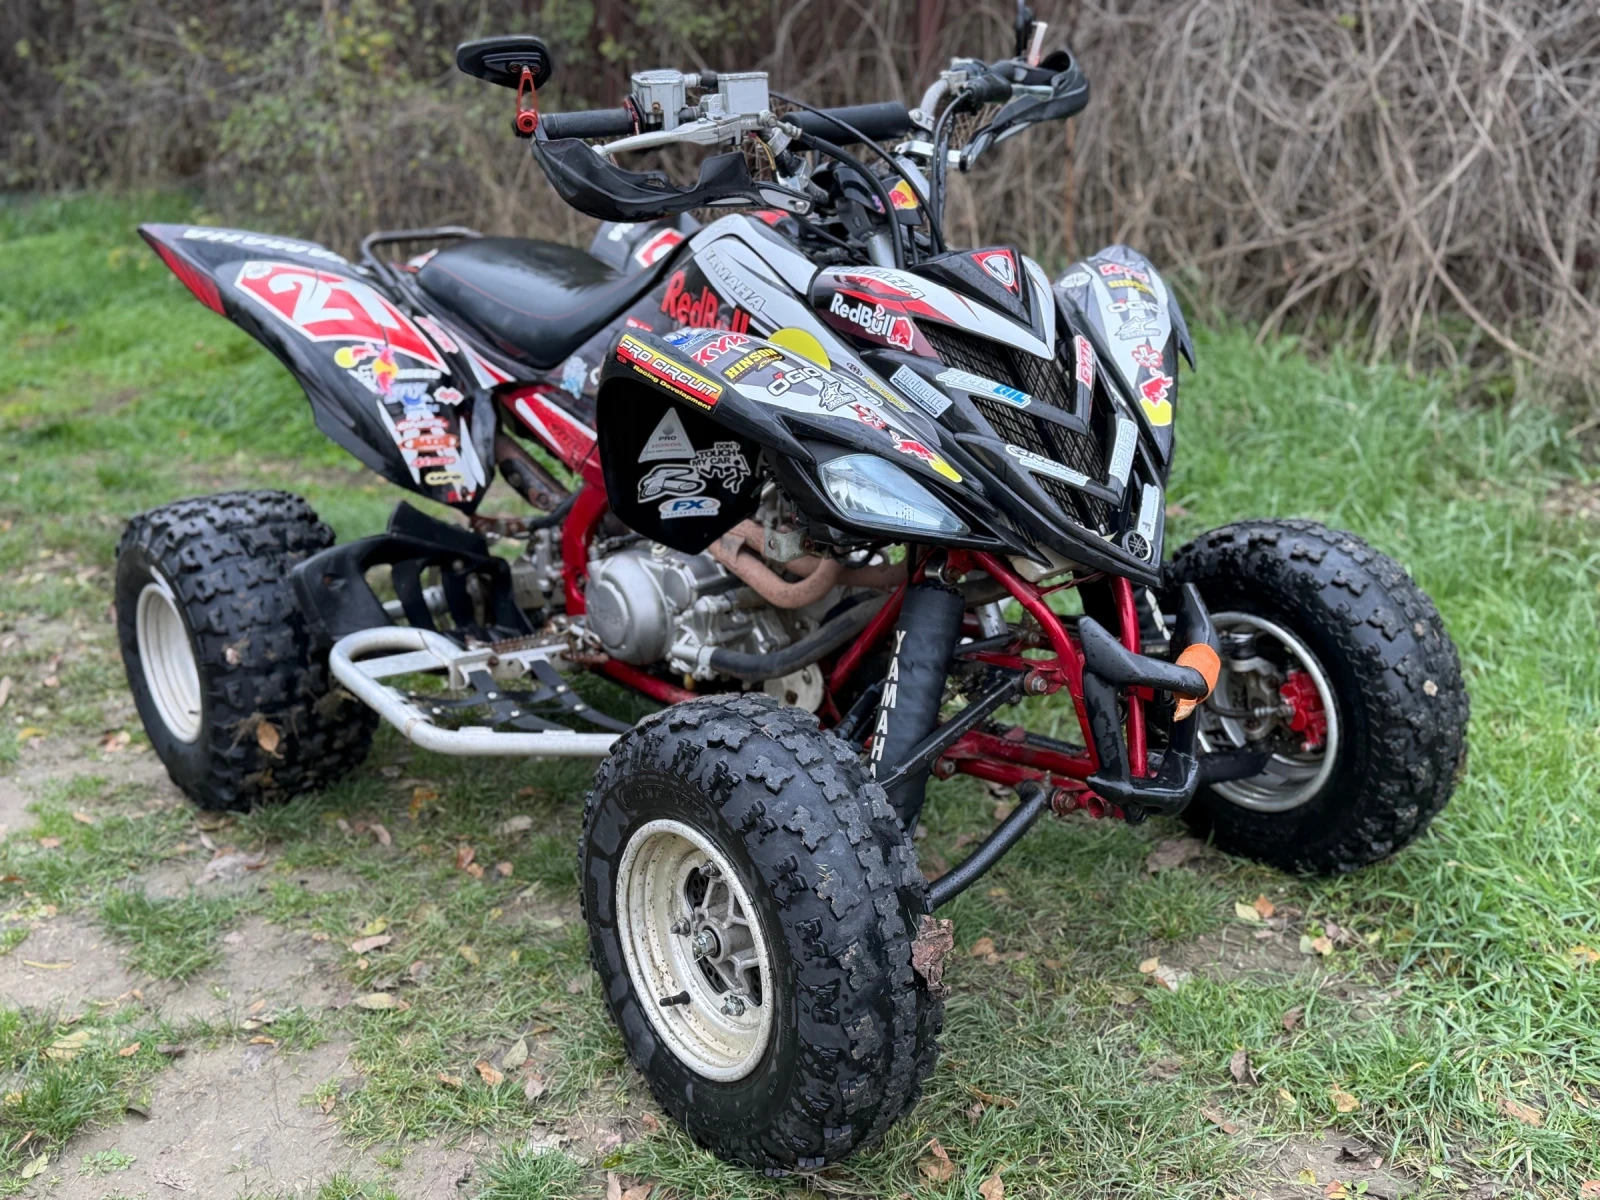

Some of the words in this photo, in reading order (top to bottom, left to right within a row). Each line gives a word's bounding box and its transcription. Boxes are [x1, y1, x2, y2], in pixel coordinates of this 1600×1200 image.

[704, 247, 766, 312] YAMAHA
[620, 340, 652, 362] PRO
[652, 358, 717, 396] CIRCUIT
[724, 348, 778, 380] HINSON
[633, 365, 659, 383] Racing
[660, 380, 712, 411] Development
[651, 441, 682, 449] HONDA
[698, 448, 737, 459] TOUCH
[716, 442, 740, 450] DON'T
[1110, 421, 1136, 486] APPLIED
[692, 459, 708, 467] MY
[710, 457, 732, 465] CAR
[672, 499, 707, 511] FX
[870, 630, 907, 779] YAMAHA
